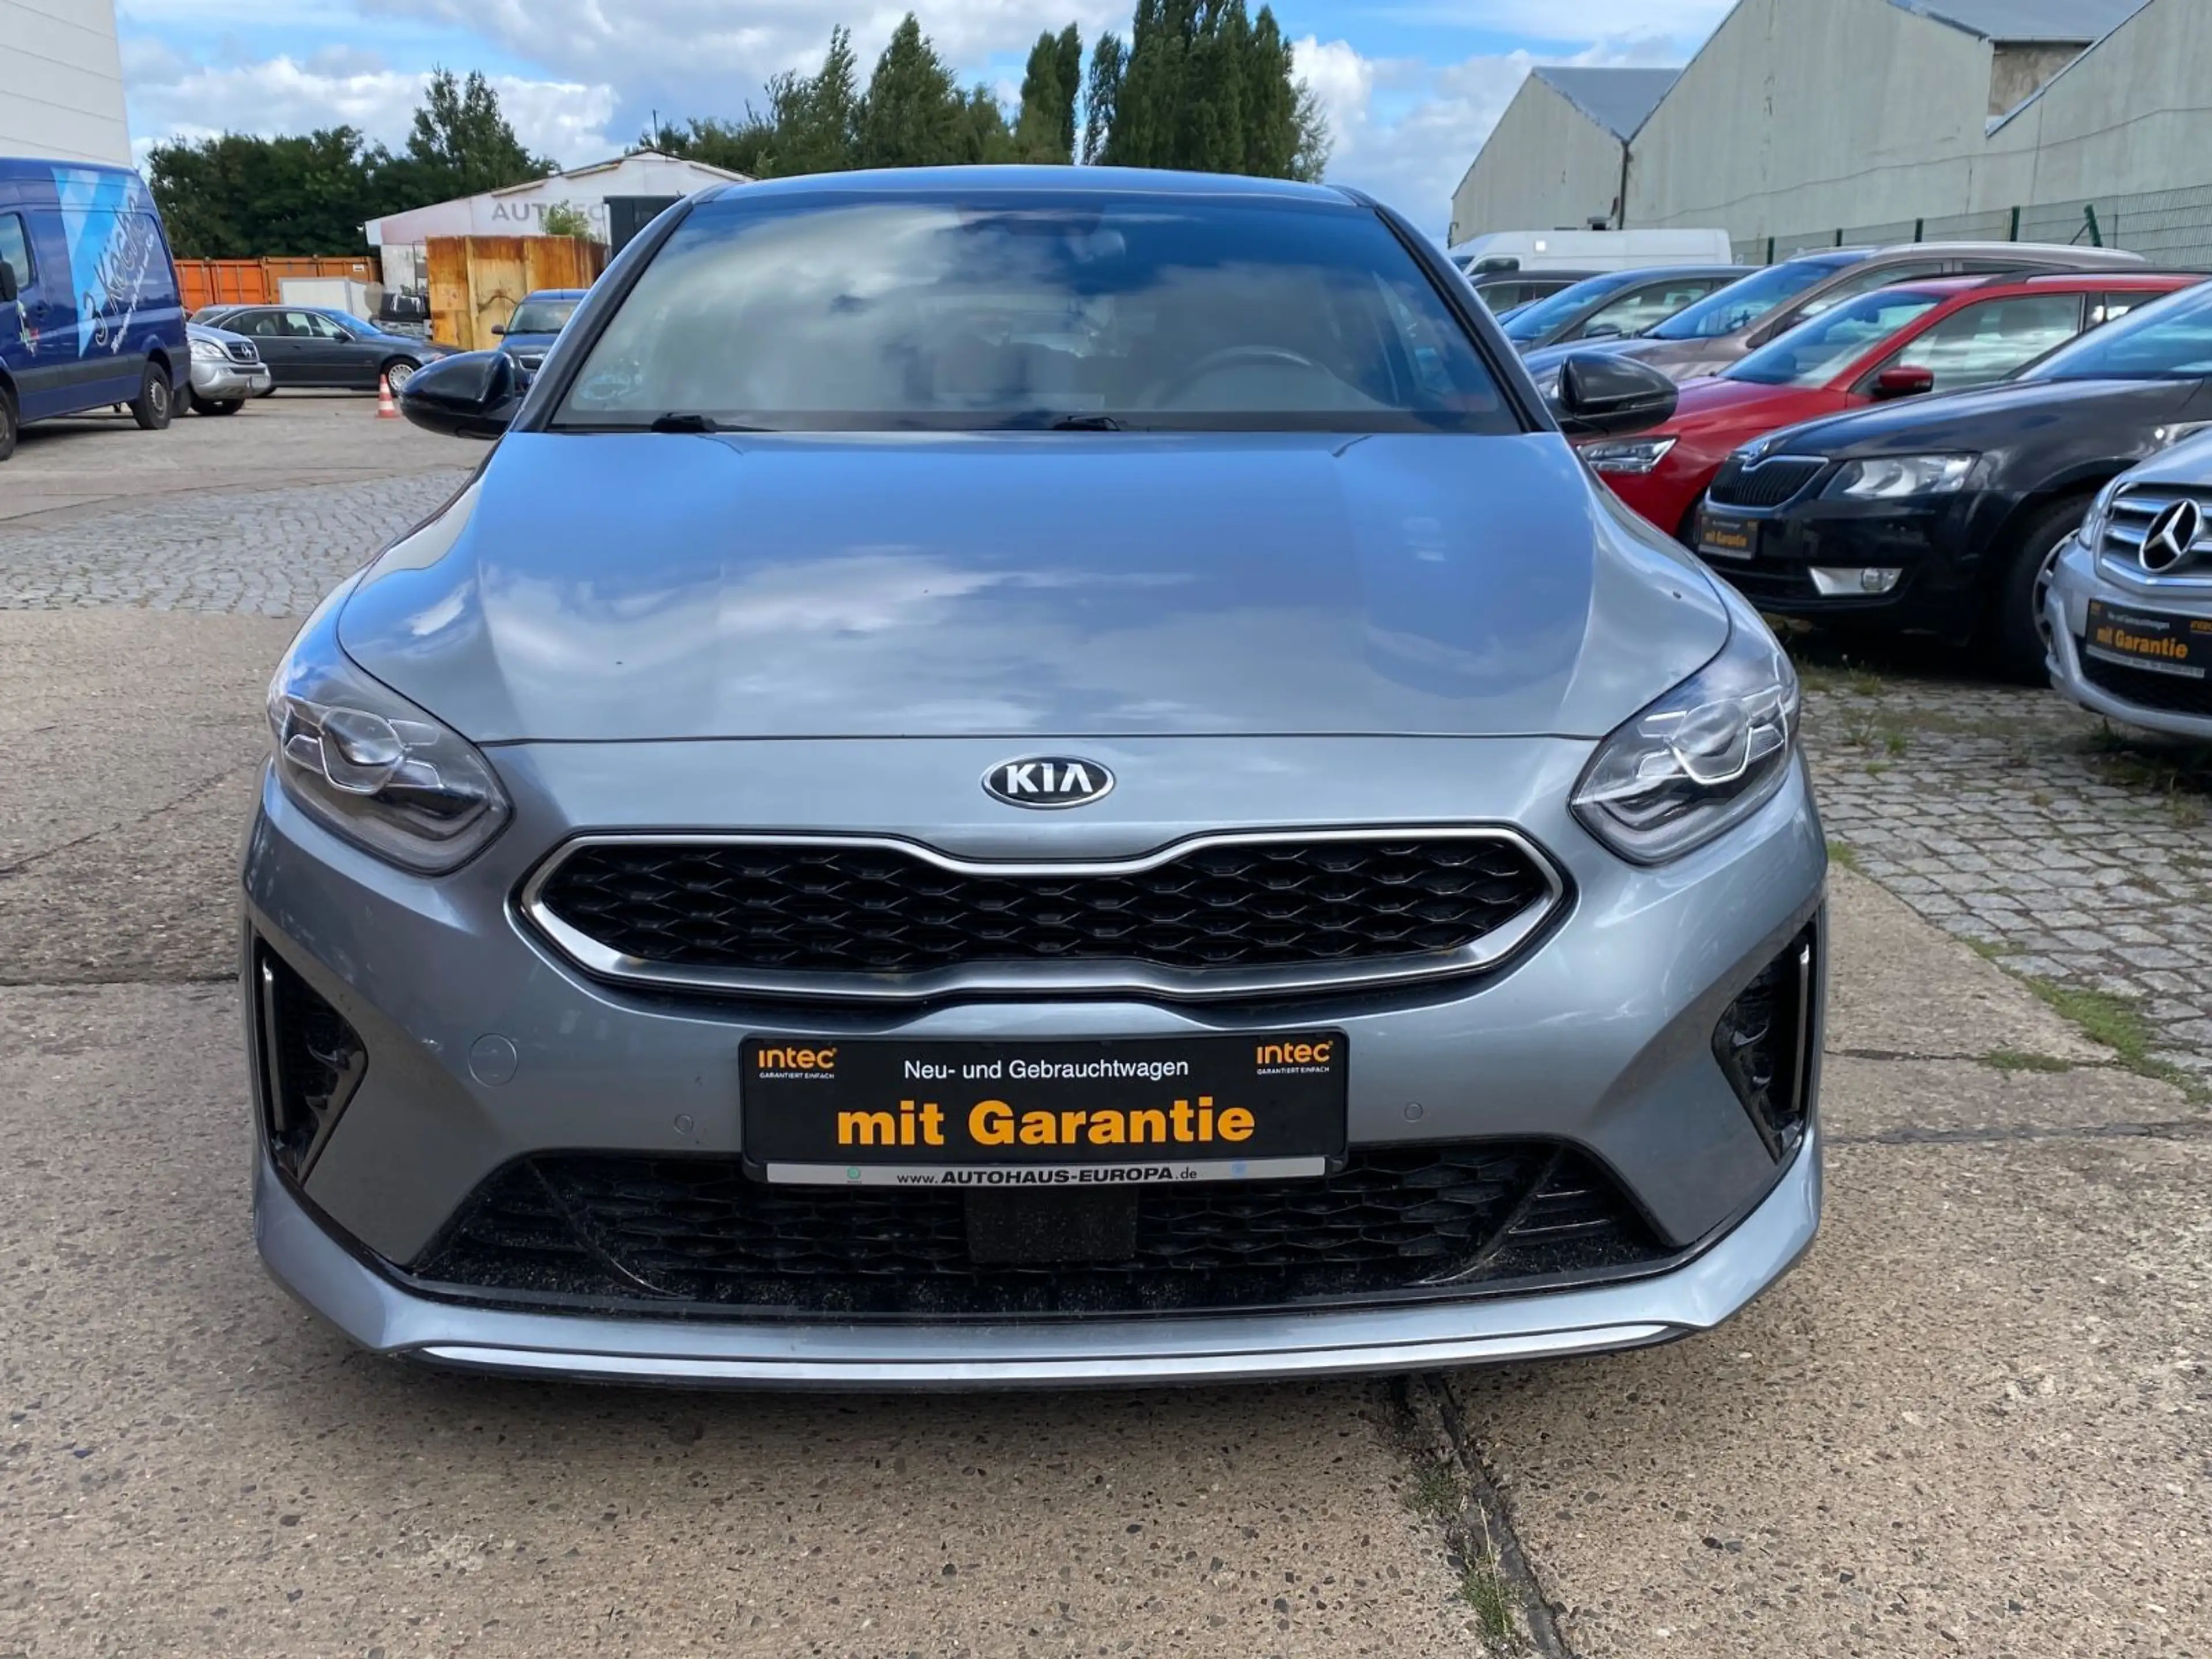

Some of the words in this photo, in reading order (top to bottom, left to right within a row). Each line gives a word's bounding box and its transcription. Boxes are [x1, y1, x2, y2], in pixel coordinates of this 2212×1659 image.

[2115, 628, 2188, 659] Garantie
[1006, 763, 1093, 794] KIA
[758, 1047, 835, 1069] intec
[1256, 1041, 1331, 1064] intec
[904, 1060, 956, 1079] Neu-
[963, 1060, 1002, 1079] und
[1009, 1059, 1188, 1081] Gebrauchtwagen
[1256, 1067, 1299, 1075] GARANTIERT
[1301, 1066, 1330, 1074] EINFACH
[838, 1100, 945, 1145] mit
[968, 1096, 1255, 1145] Garantie
[897, 1166, 1198, 1185] www.AUTOHAUS-EUROPA.de
